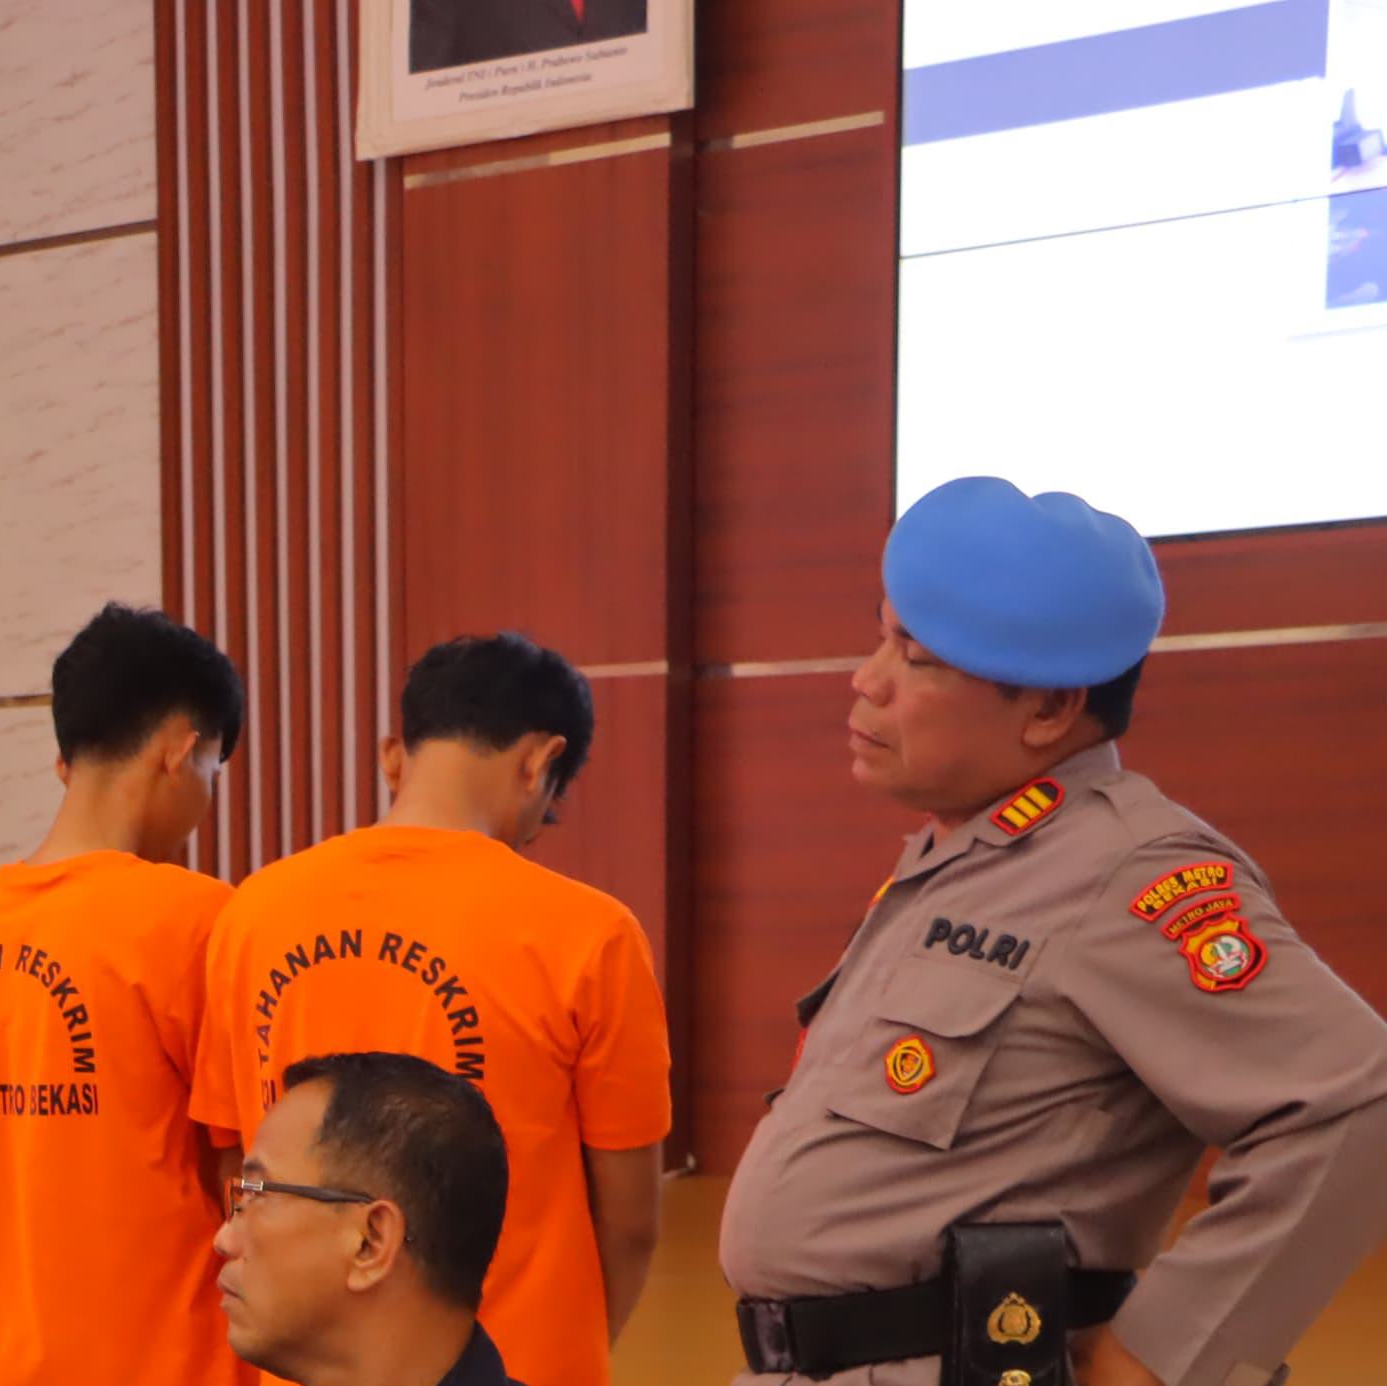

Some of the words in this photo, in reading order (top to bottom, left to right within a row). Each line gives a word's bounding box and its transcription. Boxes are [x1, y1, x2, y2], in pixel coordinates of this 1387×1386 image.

[924, 917, 1030, 970] POLRI
[14, 943, 96, 1073] RESKRIM
[378, 932, 485, 1080] RESKRIM
[30, 1083, 99, 1116] BEKASI
